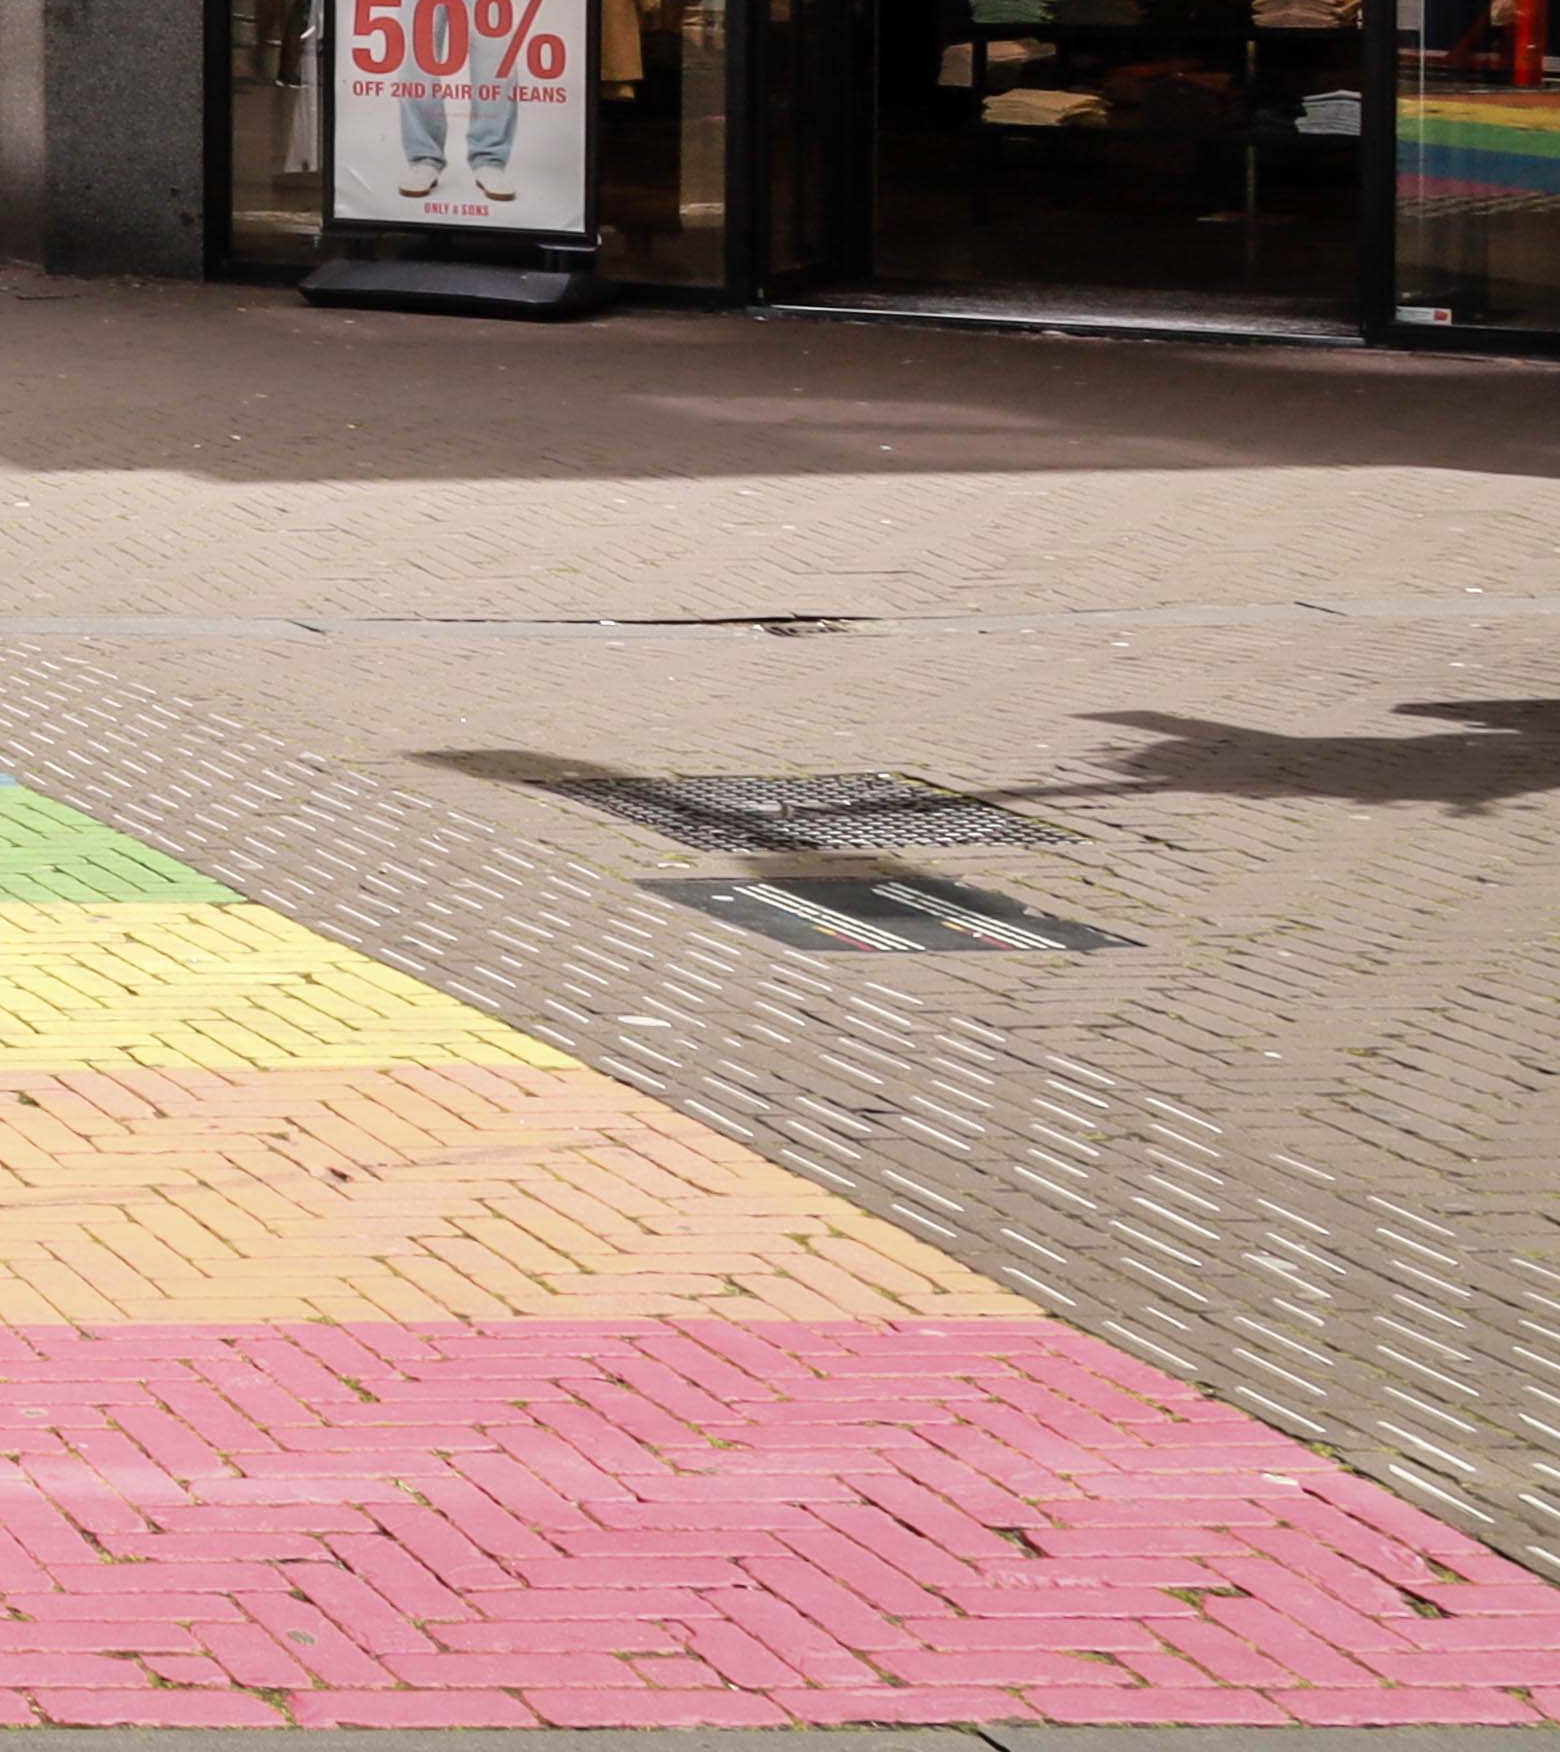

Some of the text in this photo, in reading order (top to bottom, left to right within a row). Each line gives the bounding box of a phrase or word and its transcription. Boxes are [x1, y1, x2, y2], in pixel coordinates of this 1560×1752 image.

[353, 80, 568, 104] OFF 2ND PAIR OF JEANS
[424, 202, 449, 215] ONLY
[461, 203, 490, 217] SONS
